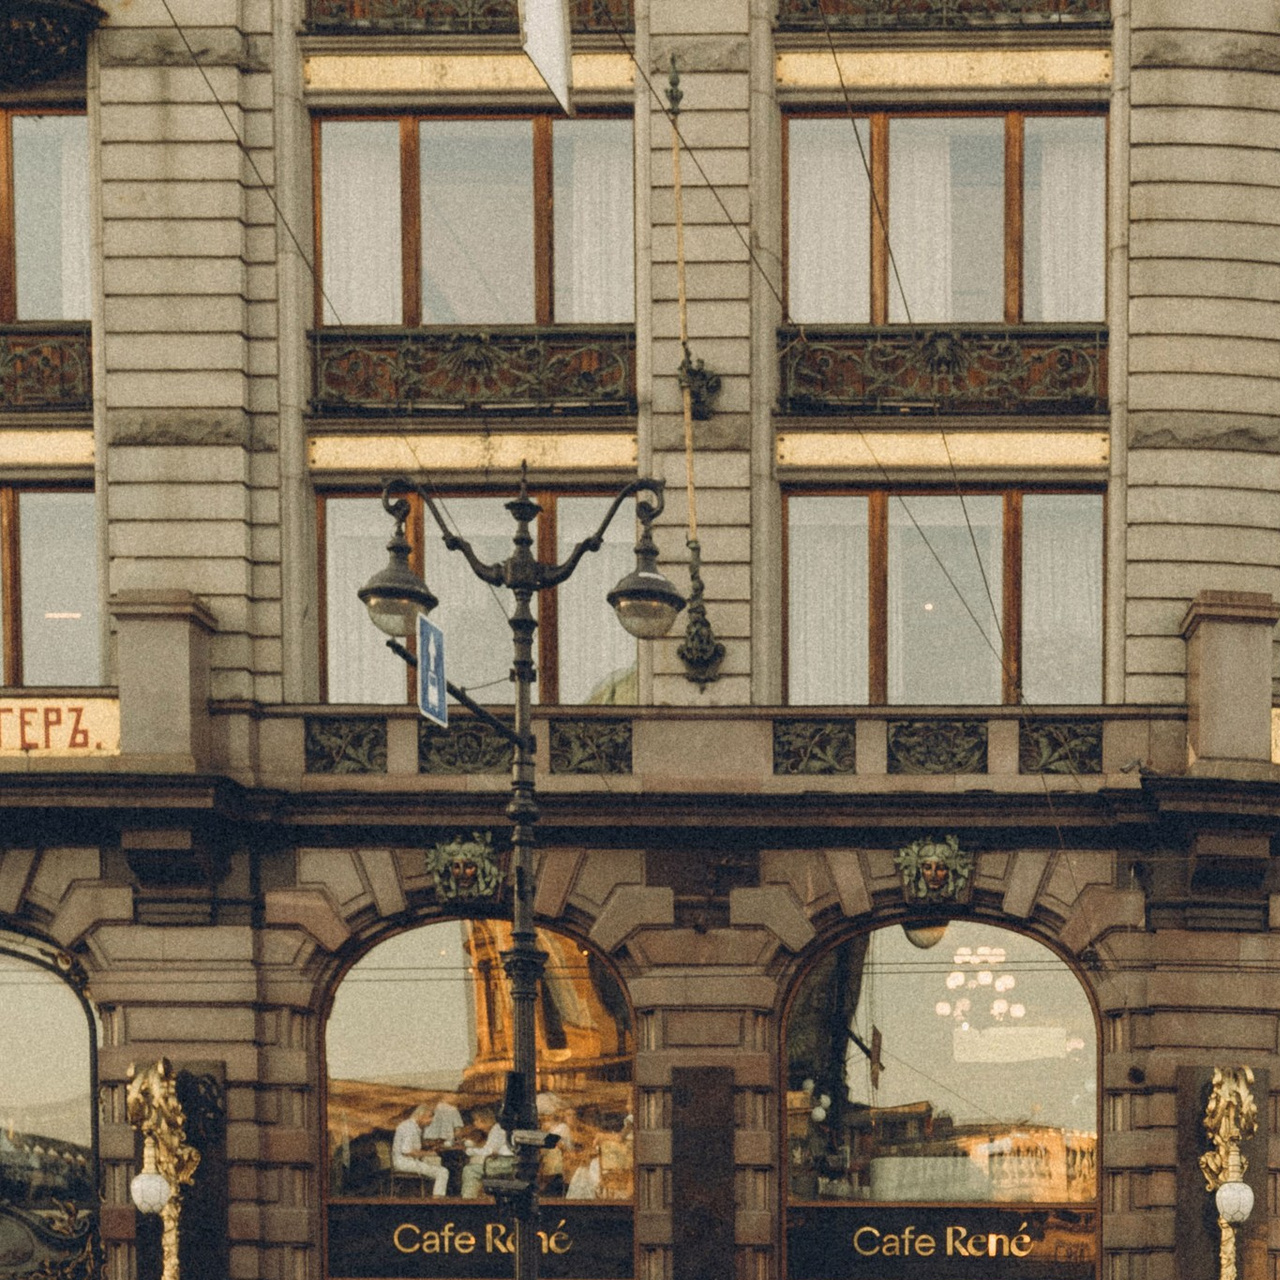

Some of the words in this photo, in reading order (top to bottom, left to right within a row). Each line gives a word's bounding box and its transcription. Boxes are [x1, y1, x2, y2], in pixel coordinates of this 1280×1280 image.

[393, 1222, 476, 1254] Cafe
[853, 1226, 936, 1257] Cafe
[946, 1221, 1034, 1258] René
